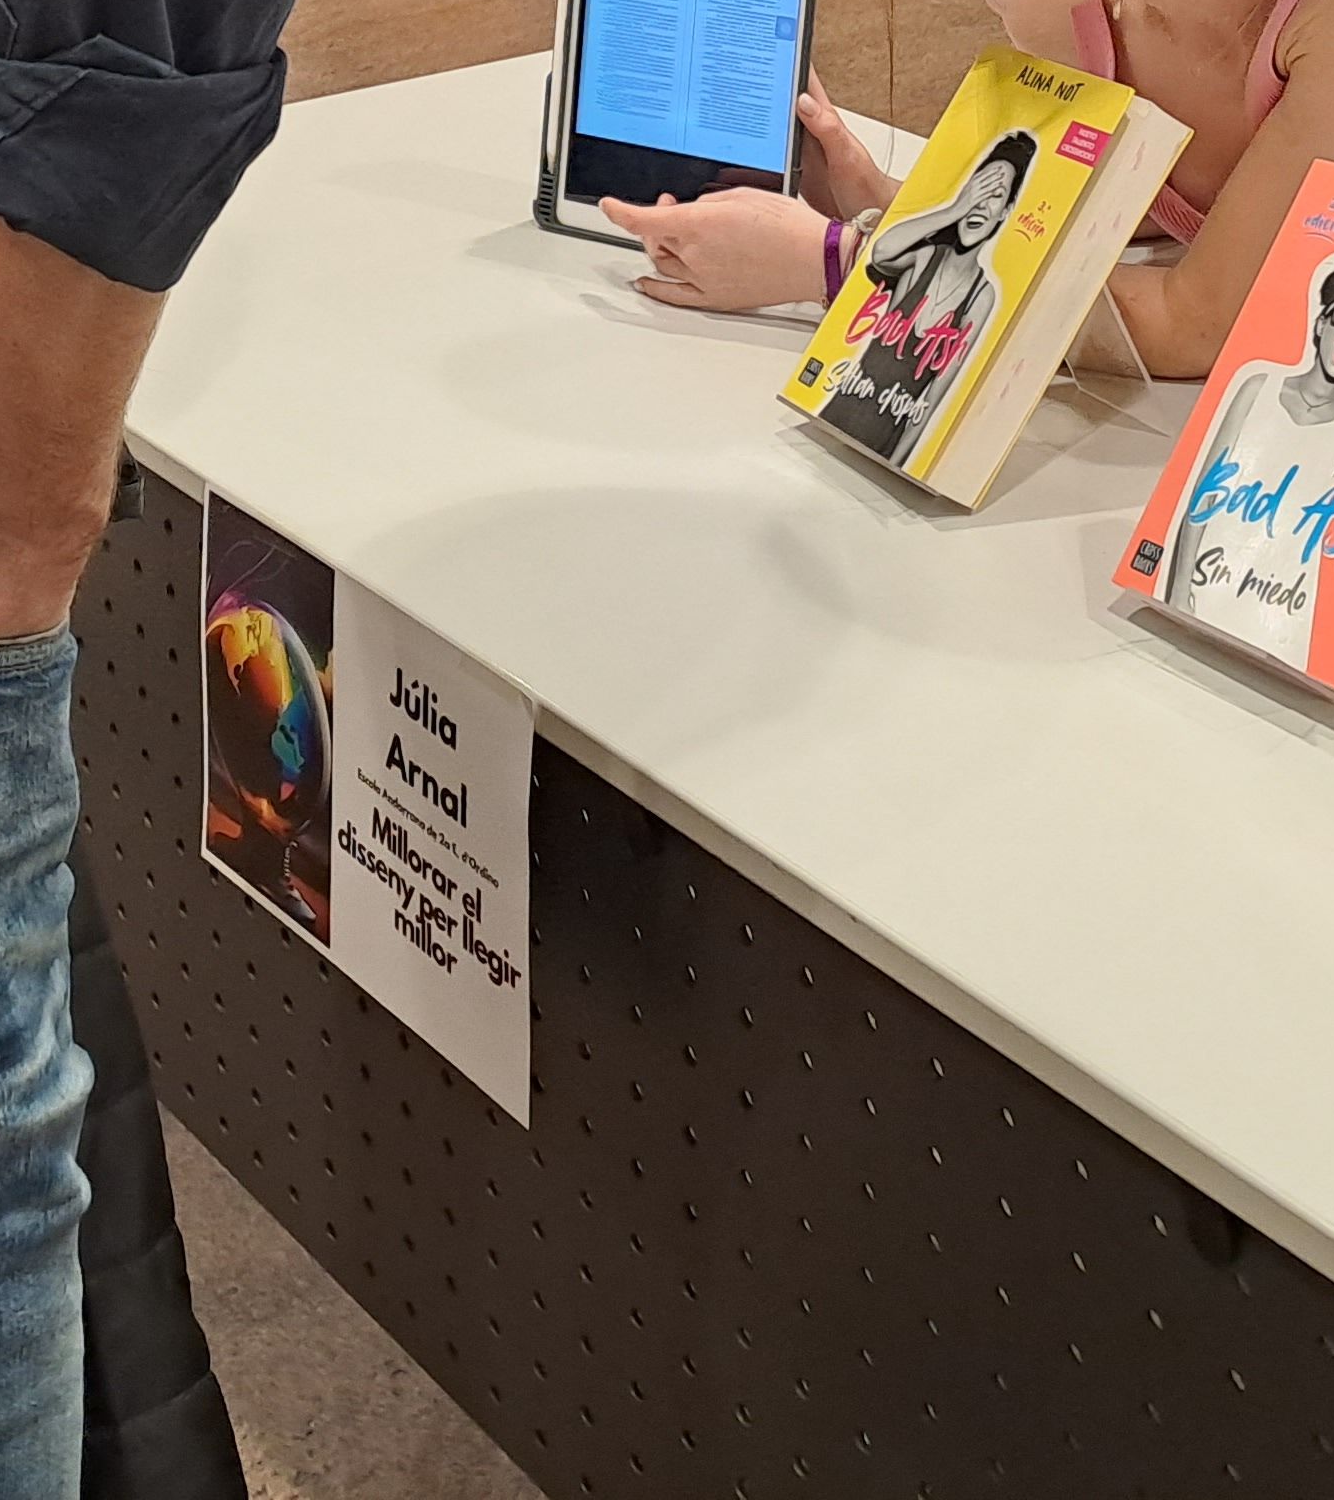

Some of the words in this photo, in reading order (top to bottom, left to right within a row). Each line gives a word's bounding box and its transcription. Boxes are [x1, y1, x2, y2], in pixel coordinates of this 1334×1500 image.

[1016, 65, 1054, 93] ALINA
[1054, 81, 1085, 102] NOT
[845, 280, 929, 360] Bad
[914, 311, 973, 380] Ash
[1189, 446, 1300, 539] Bad
[1191, 547, 1232, 587] Sin
[1237, 567, 1307, 616] miedo
[389, 667, 457, 750] Júlia
[385, 733, 467, 828] Arnal
[338, 819, 415, 911] disseny
[419, 893, 458, 939] per
[463, 913, 521, 989] llegir
[371, 806, 458, 900] Millorar
[462, 887, 481, 924] el
[394, 908, 458, 974] millor
